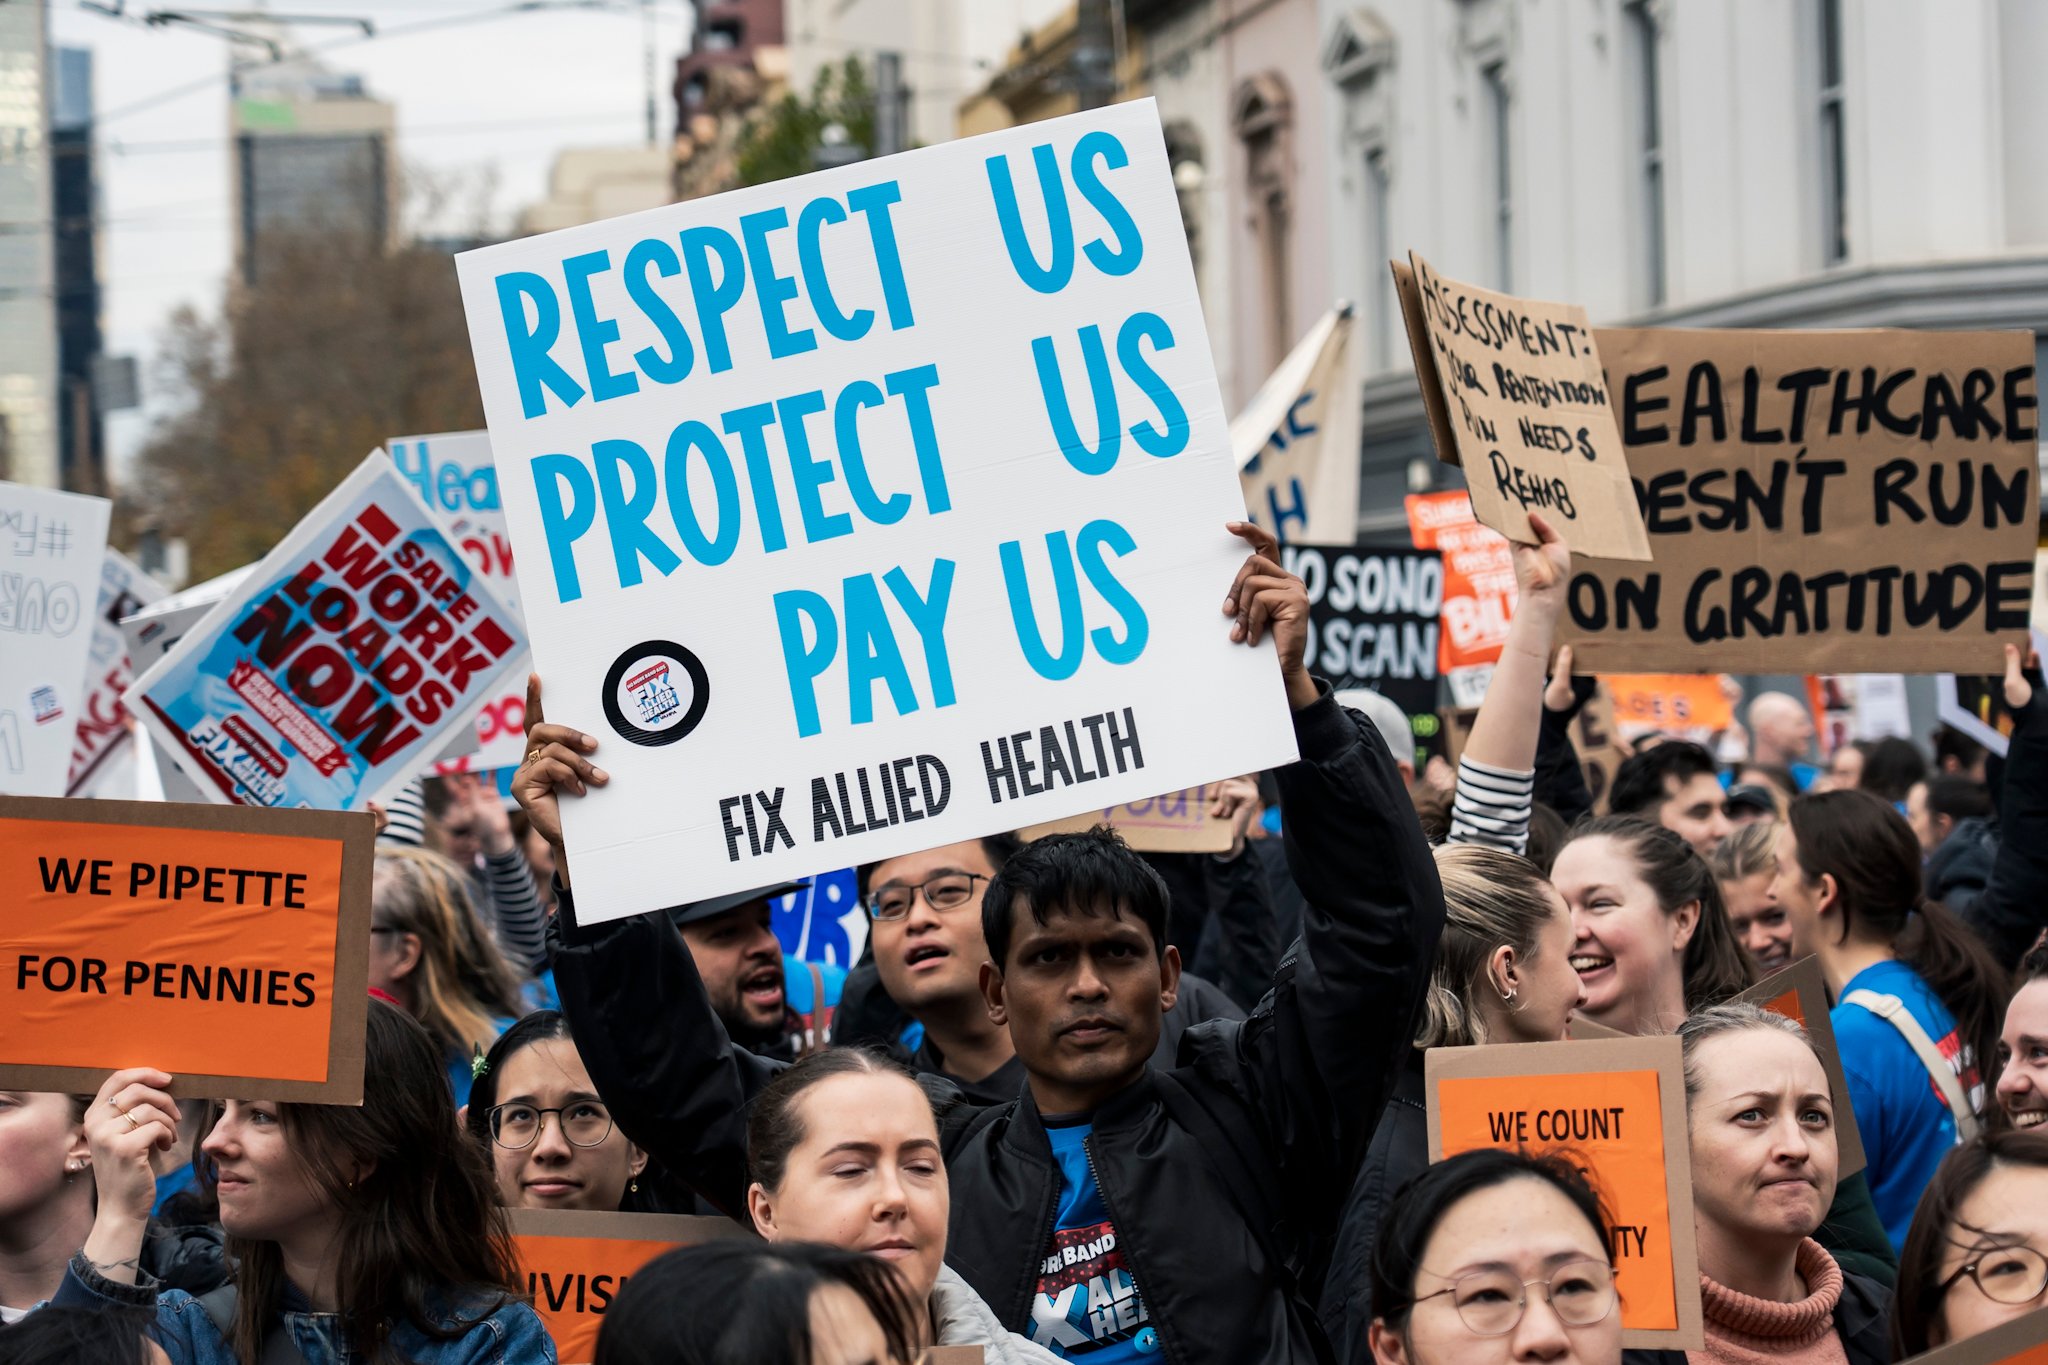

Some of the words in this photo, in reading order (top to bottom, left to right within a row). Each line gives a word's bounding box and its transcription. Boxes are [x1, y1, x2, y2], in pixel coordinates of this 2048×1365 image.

[495, 181, 914, 419] RESPECT
[986, 132, 1143, 294] US
[1422, 265, 1591, 357] ASSESSMENT:
[1518, 415, 1596, 461] NEEDS
[1603, 361, 2038, 446] EALTHCARE
[531, 364, 951, 603] PROTECT
[1032, 312, 1190, 475] US
[1489, 450, 1576, 520] REHAB
[1631, 446, 1846, 534] ESN'T
[1874, 459, 2029, 529] RUN
[323, 524, 493, 695] WORK
[393, 540, 480, 624] SAFE
[1328, 555, 1444, 618] SONO
[1568, 573, 1661, 631] ON
[1684, 562, 2034, 643] GRATITUDE
[282, 560, 455, 726] LOADS
[773, 558, 956, 738] PAY
[999, 520, 1148, 680] US
[1320, 617, 1438, 681] SCAN
[232, 593, 423, 768] NOW
[631, 672, 673, 707] FIX
[640, 690, 674, 712] ALLIED
[641, 699, 677, 722] HEALTH
[189, 714, 250, 768] FIX
[718, 787, 796, 861] FIX
[812, 755, 950, 841] ALLIED
[979, 707, 1145, 803] HEALTH
[39, 857, 113, 895] WE
[130, 863, 307, 909] PIPETTE
[17, 955, 107, 994] FOR
[124, 961, 315, 1007] PENNIES
[1488, 1111, 1529, 1143] WE
[1536, 1107, 1624, 1142] COUNT
